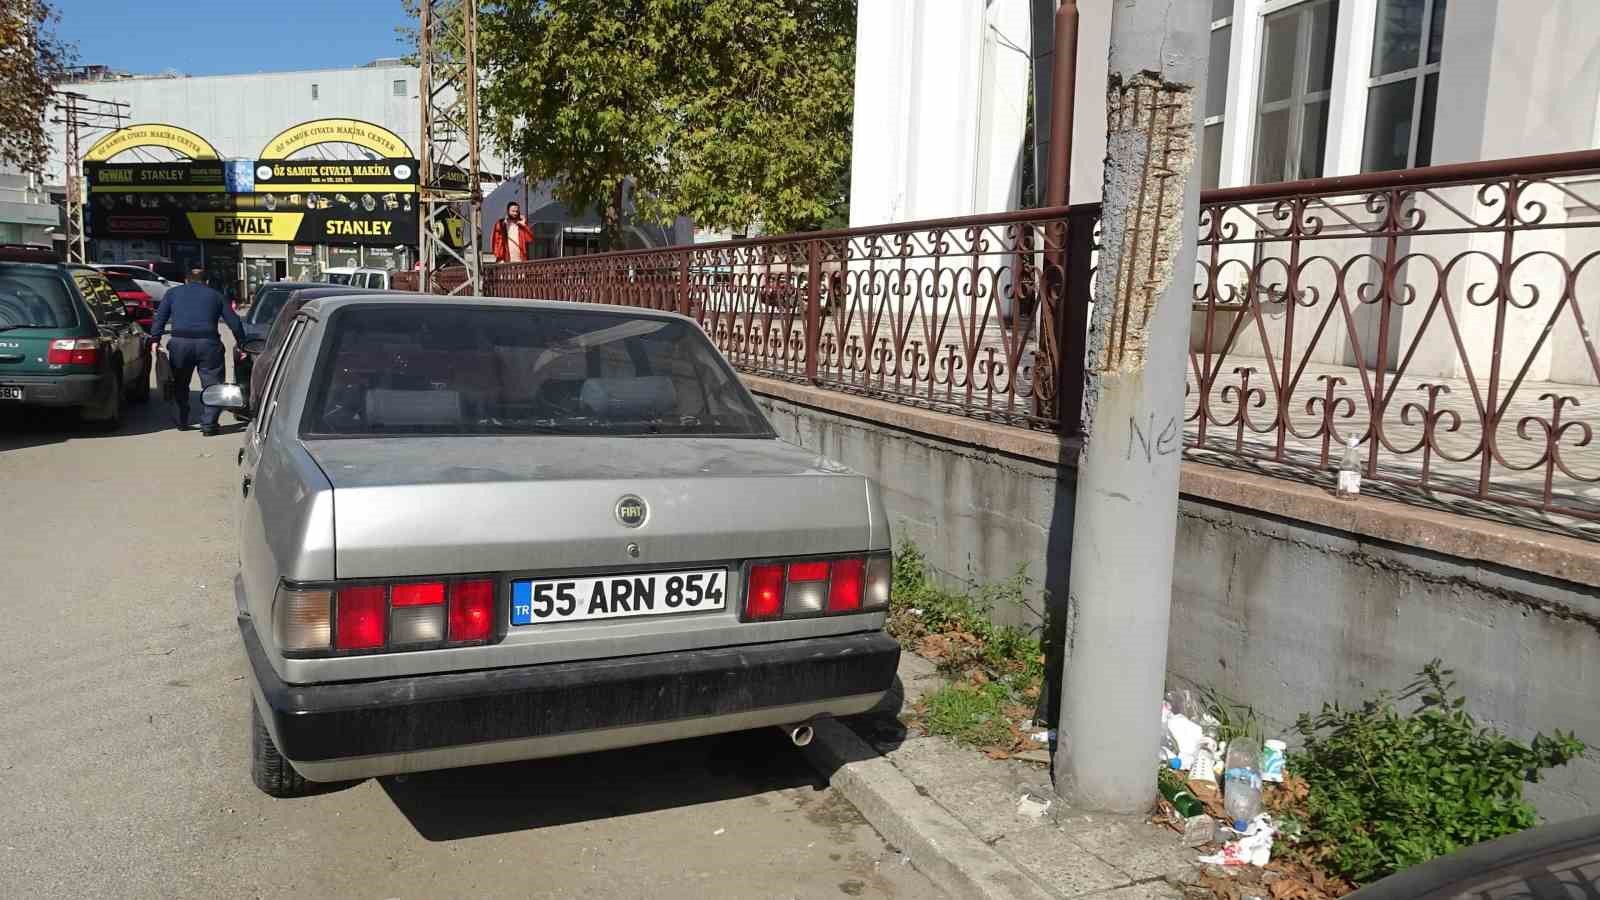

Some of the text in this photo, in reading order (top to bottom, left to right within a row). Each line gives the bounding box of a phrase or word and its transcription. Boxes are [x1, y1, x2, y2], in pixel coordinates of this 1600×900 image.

[285, 129, 308, 147] SAMUK
[366, 131, 396, 152] CENTER
[140, 169, 184, 181] STANLEY
[273, 163, 285, 176] ÖZ
[286, 166, 318, 176] SAMUK
[319, 165, 351, 176] CIVATA
[353, 163, 391, 176] MAKİNA
[325, 219, 392, 236] STANLEY
[620, 506, 641, 517] FIAT
[533, 572, 723, 618] 55 ARN 854
[515, 604, 530, 616] TR
